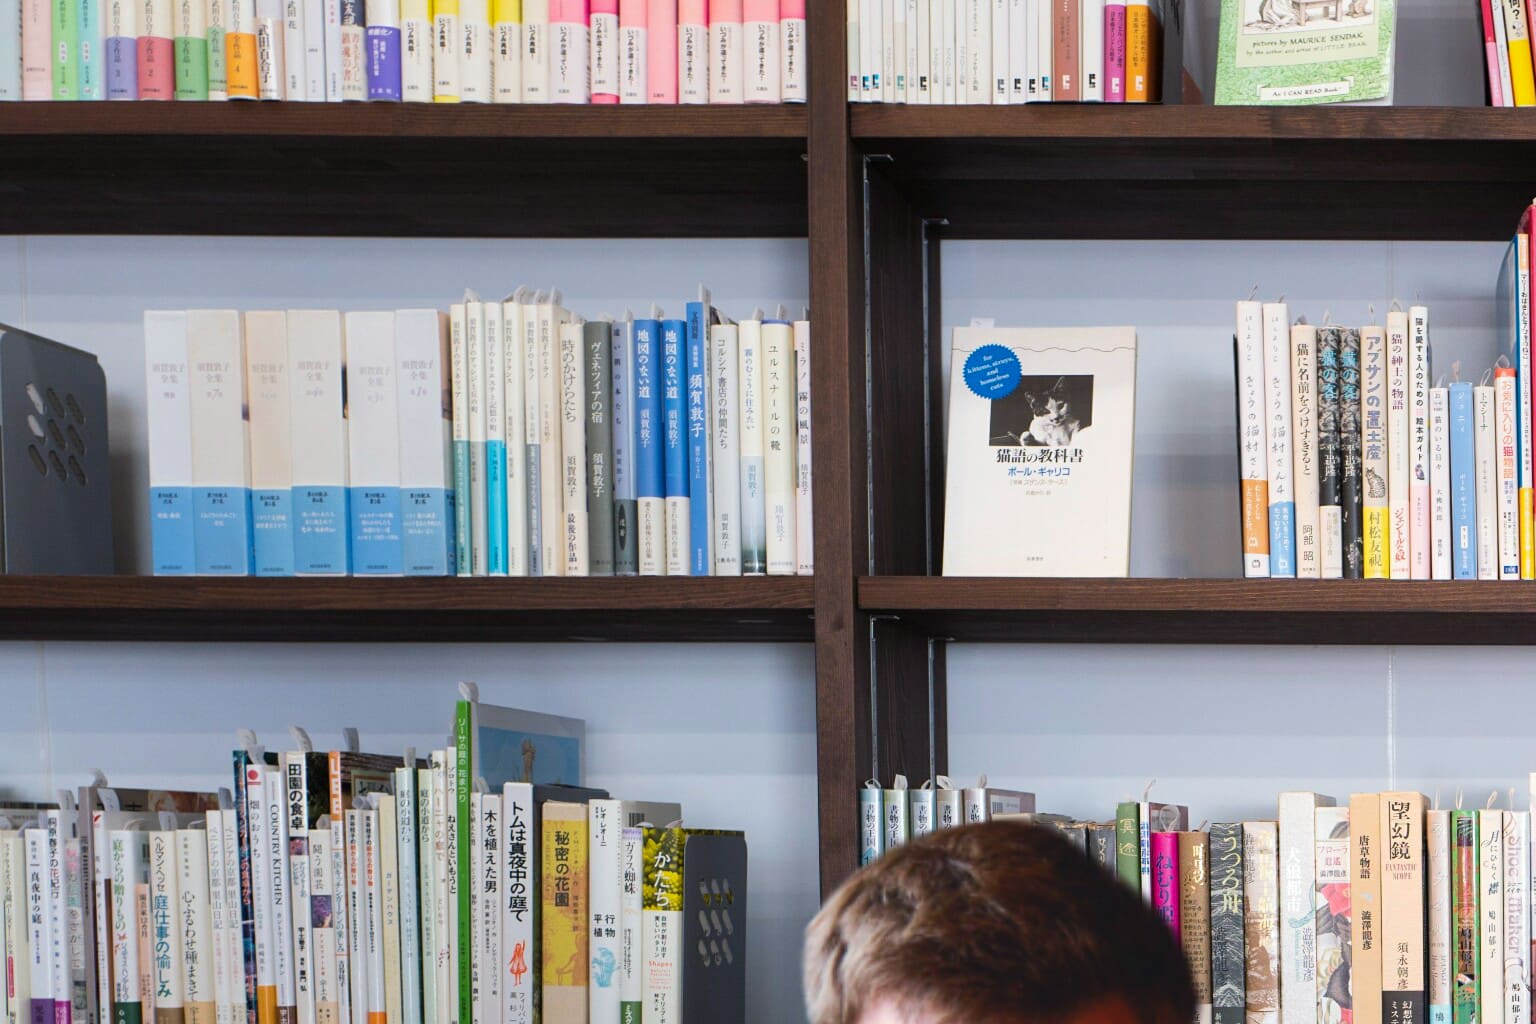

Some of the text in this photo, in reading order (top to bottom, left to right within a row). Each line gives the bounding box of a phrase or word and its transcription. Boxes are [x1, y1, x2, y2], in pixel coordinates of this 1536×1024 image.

[1290, 36, 1326, 45] MAURICE
[1330, 32, 1363, 41] SENDAK
[562, 340, 576, 423] 時のかけらたち
[638, 329, 650, 398] 地図のない道
[665, 329, 677, 398] 地図のない道
[717, 339, 728, 449] コルシア書店の仲間たち
[769, 346, 781, 451] ユルスナールの靴
[1366, 336, 1382, 461] アブサンの置土産
[689, 374, 703, 437] 須賀敦子
[1297, 343, 1313, 476] 猫に名前をつけすぎると
[996, 449, 1083, 464] 猫語の教科書
[1008, 467, 1071, 477] ポール・ギャリコ
[288, 763, 304, 830] 田園の食卓
[269, 804, 282, 906] COUNTRY KITCHEN
[484, 810, 498, 893] 木を植えた男
[507, 801, 529, 923] トムは真夜中の庭で
[554, 830, 570, 907] 秘密の花園
[654, 851, 672, 907] かたち
[1220, 829, 1241, 915] うつろ舟
[1359, 835, 1371, 879] 唐草物語
[155, 895, 172, 998] 庭仕事の愉しみ
[1512, 983, 1521, 1024] 鳩山郁子
